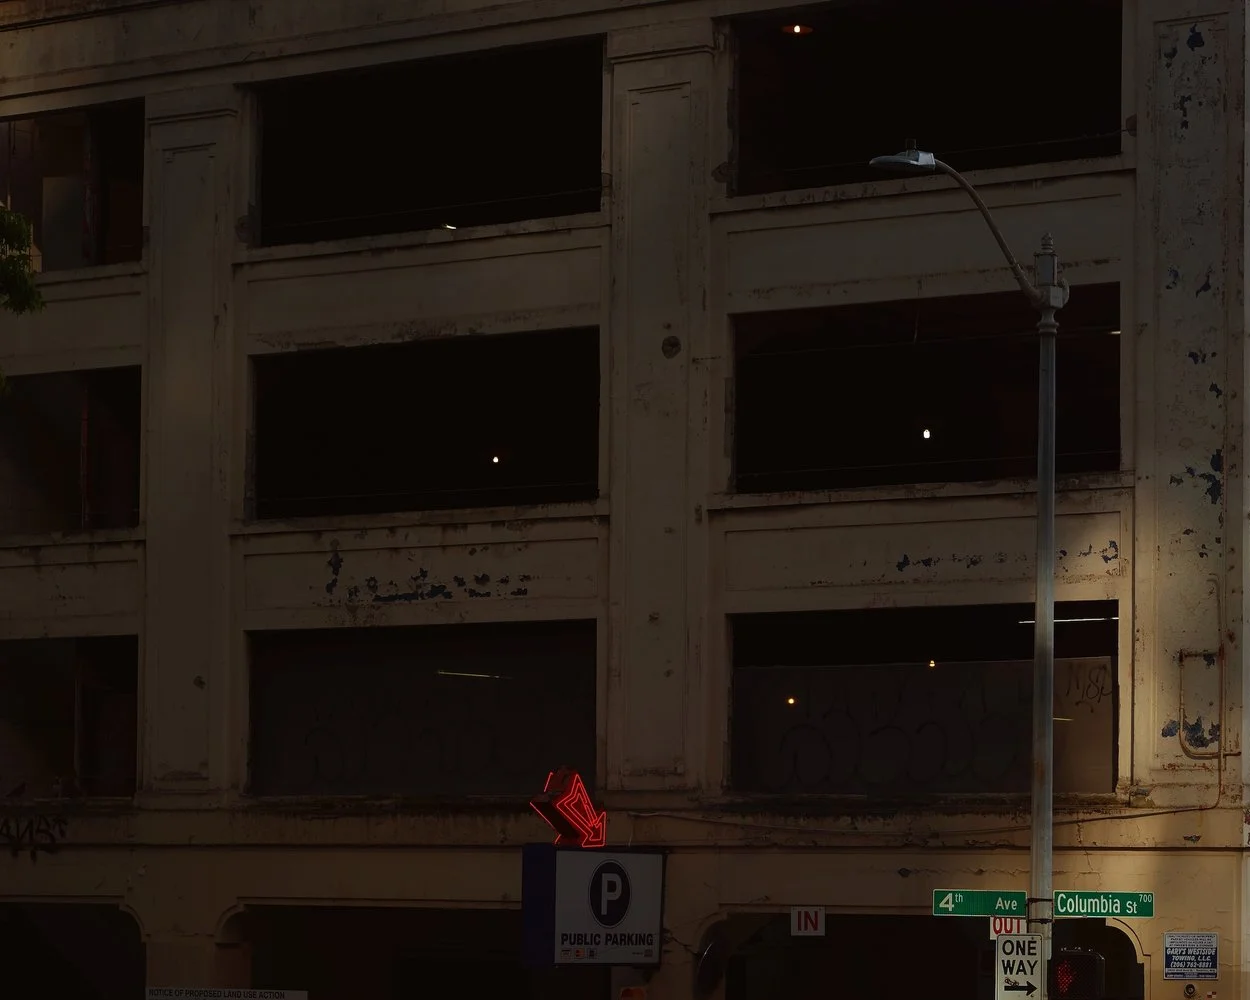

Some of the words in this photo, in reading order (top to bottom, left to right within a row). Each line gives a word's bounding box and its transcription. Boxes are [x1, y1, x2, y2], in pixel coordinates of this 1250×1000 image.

[601, 872, 623, 916] P
[938, 892, 964, 912] 4th
[995, 897, 1018, 911] Ave
[1057, 893, 1121, 913] Columbia
[1126, 901, 1138, 914] St
[1138, 894, 1153, 903] 700
[797, 910, 819, 931] IN
[993, 916, 1020, 934] OUT
[561, 933, 601, 946] PUBLIC
[604, 933, 654, 946] PARKING
[1002, 939, 1037, 956] ONE
[1001, 959, 1038, 976] WAY
[149, 989, 173, 998] NOTICE
[174, 990, 183, 998] OF
[185, 990, 222, 999] PROPOSED
[223, 991, 242, 999] LAND
[243, 991, 257, 999] USE
[258, 991, 285, 1000] ACTION
